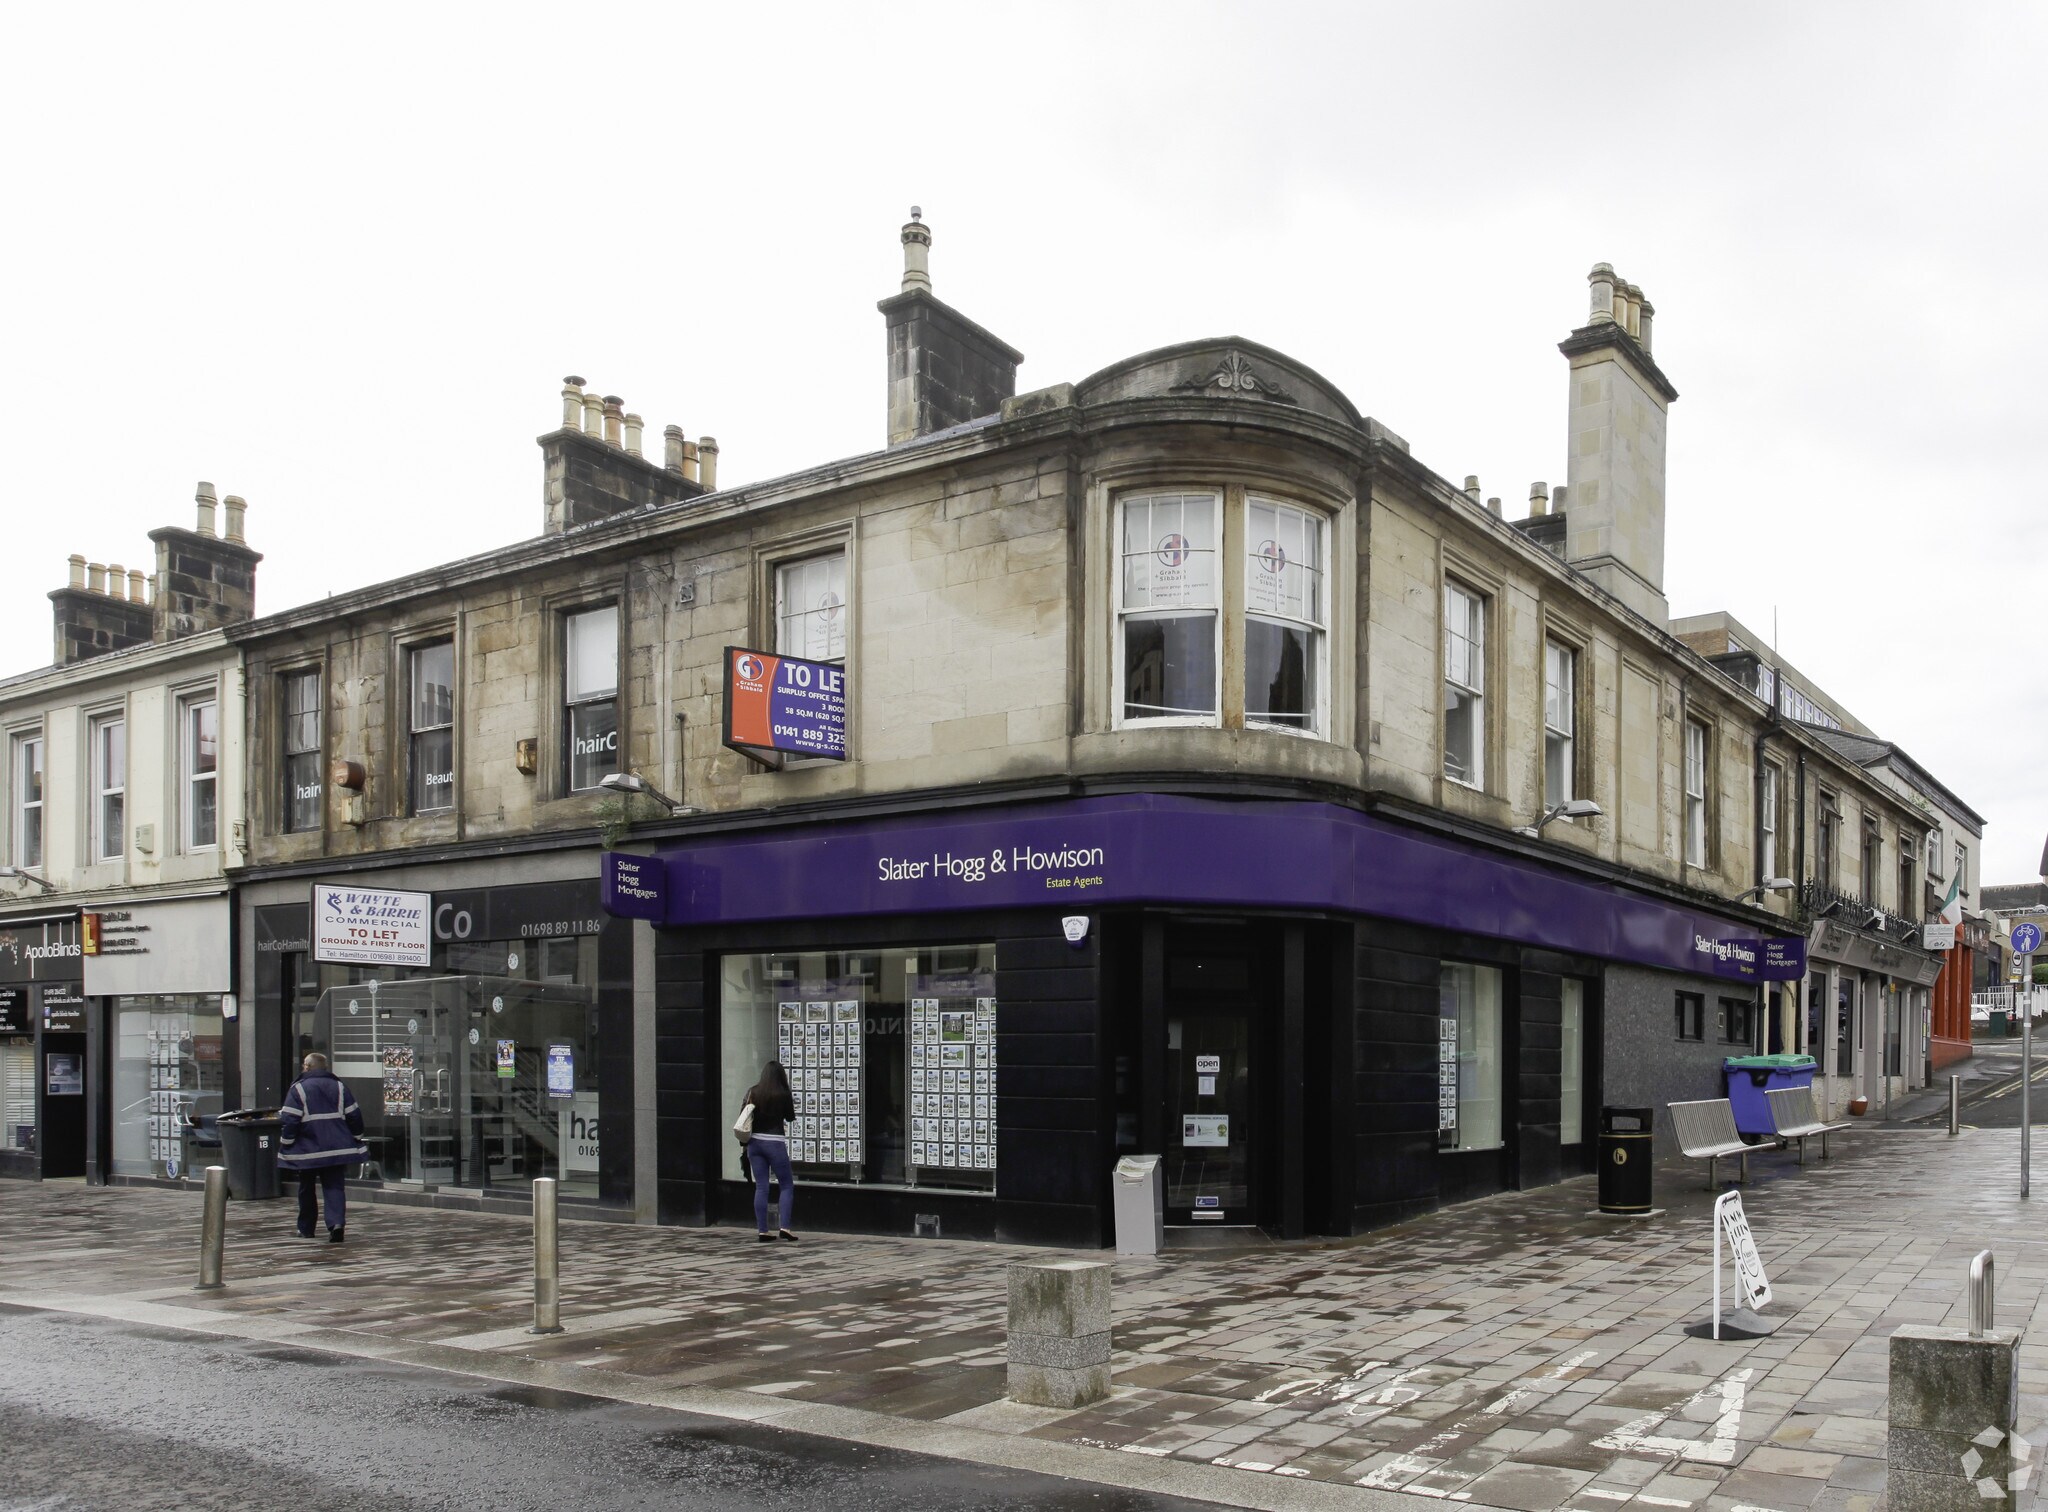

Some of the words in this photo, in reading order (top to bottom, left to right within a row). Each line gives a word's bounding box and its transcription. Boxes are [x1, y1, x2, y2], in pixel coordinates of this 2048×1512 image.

[784, 662, 811, 687] TO
[777, 686, 806, 697] SURPLUS
[808, 692, 829, 702] OFFICE
[816, 712, 830, 720] (620
[774, 724, 798, 737] 0141
[803, 729, 823, 741] 889
[426, 771, 453, 786] Beaut
[297, 784, 321, 799] hair
[618, 860, 640, 872] Slater
[878, 857, 929, 881] Slater
[934, 852, 986, 882] Hogg
[990, 849, 1007, 873] &
[1013, 843, 1104, 871] Howison
[618, 872, 639, 886] Hogg
[1046, 878, 1071, 888] Estate
[1073, 876, 1103, 889] Agents
[618, 884, 658, 899] Mortgages
[346, 894, 401, 907] WHYTE
[350, 905, 362, 915] &
[366, 907, 422, 919] BARRIE
[325, 916, 421, 928] COMMERCIAL
[435, 903, 472, 939] Co
[521, 923, 552, 936] 01698
[555, 922, 568, 934] 89
[572, 921, 583, 933] 11
[587, 920, 600, 932] 86
[348, 928, 368, 938] TO
[373, 930, 399, 940] LET
[258, 938, 310, 951] hairCoHamilt
[321, 938, 359, 946] GROUND
[1696, 934, 1711, 952] Slater
[1712, 938, 1727, 961] Hogg
[1727, 942, 1732, 958] &
[1732, 944, 1755, 962] Howison
[259, 1140, 268, 1149] 18
